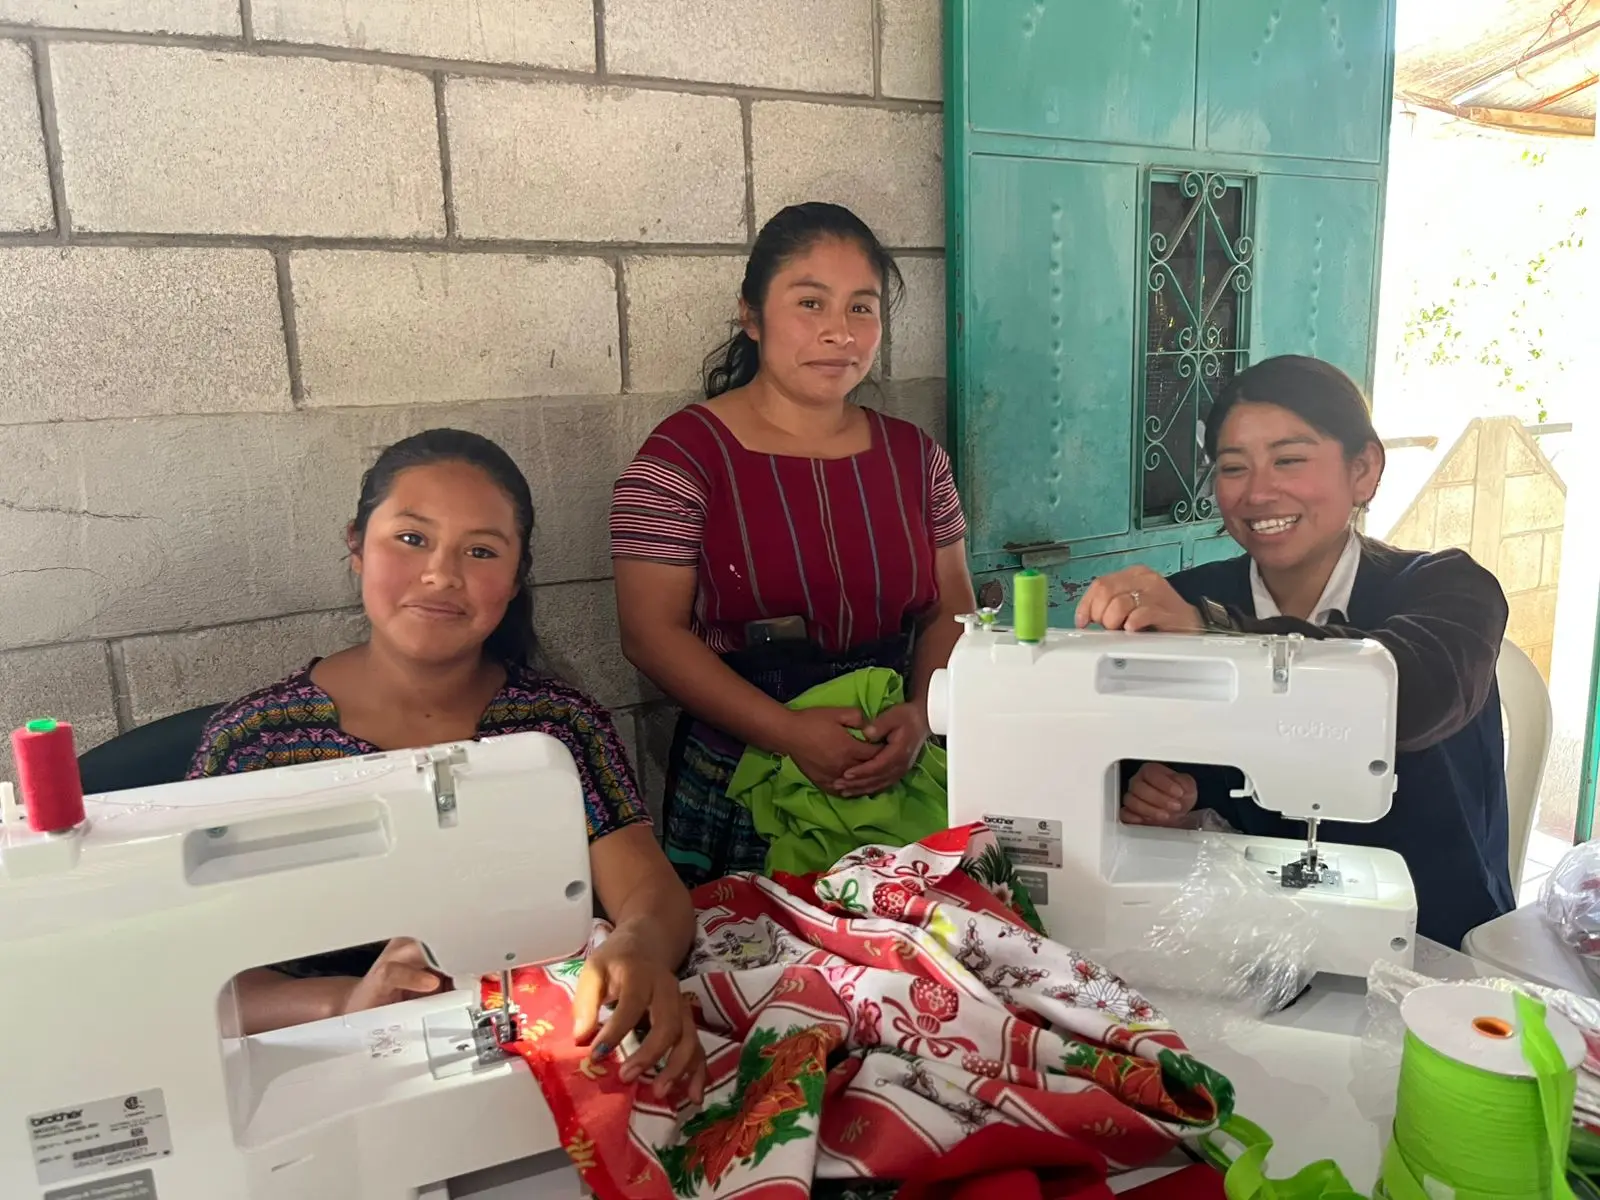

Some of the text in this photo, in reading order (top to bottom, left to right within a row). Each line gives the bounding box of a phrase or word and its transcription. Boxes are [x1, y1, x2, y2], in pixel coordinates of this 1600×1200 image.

[1276, 718, 1351, 742] brother
[984, 816, 1014, 825] brother
[30, 1109, 84, 1127] brother
